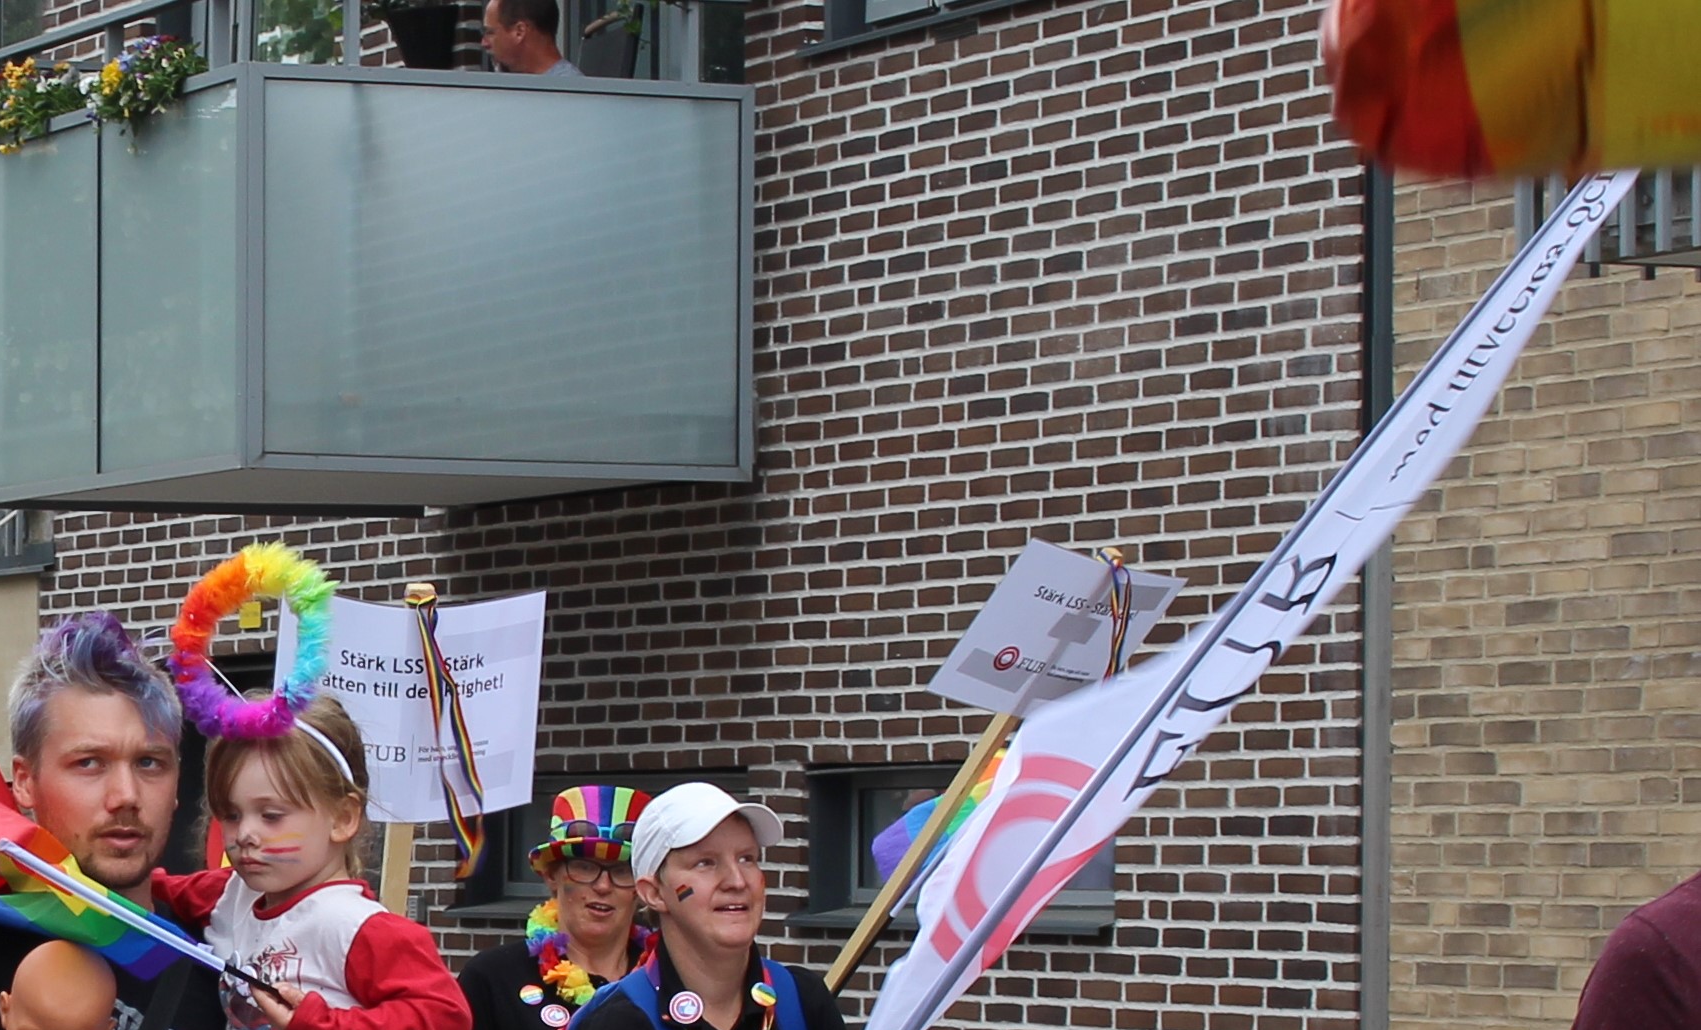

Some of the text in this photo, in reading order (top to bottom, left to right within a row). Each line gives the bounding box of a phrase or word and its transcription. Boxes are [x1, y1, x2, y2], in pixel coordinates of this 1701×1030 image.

[1034, 585, 1064, 604] Stärk
[1066, 596, 1087, 610] LSS
[340, 650, 386, 672] Stärk
[393, 658, 424, 674] LSS
[1017, 656, 1047, 675] FUB
[322, 671, 367, 695] ätten
[373, 682, 398, 698] till
